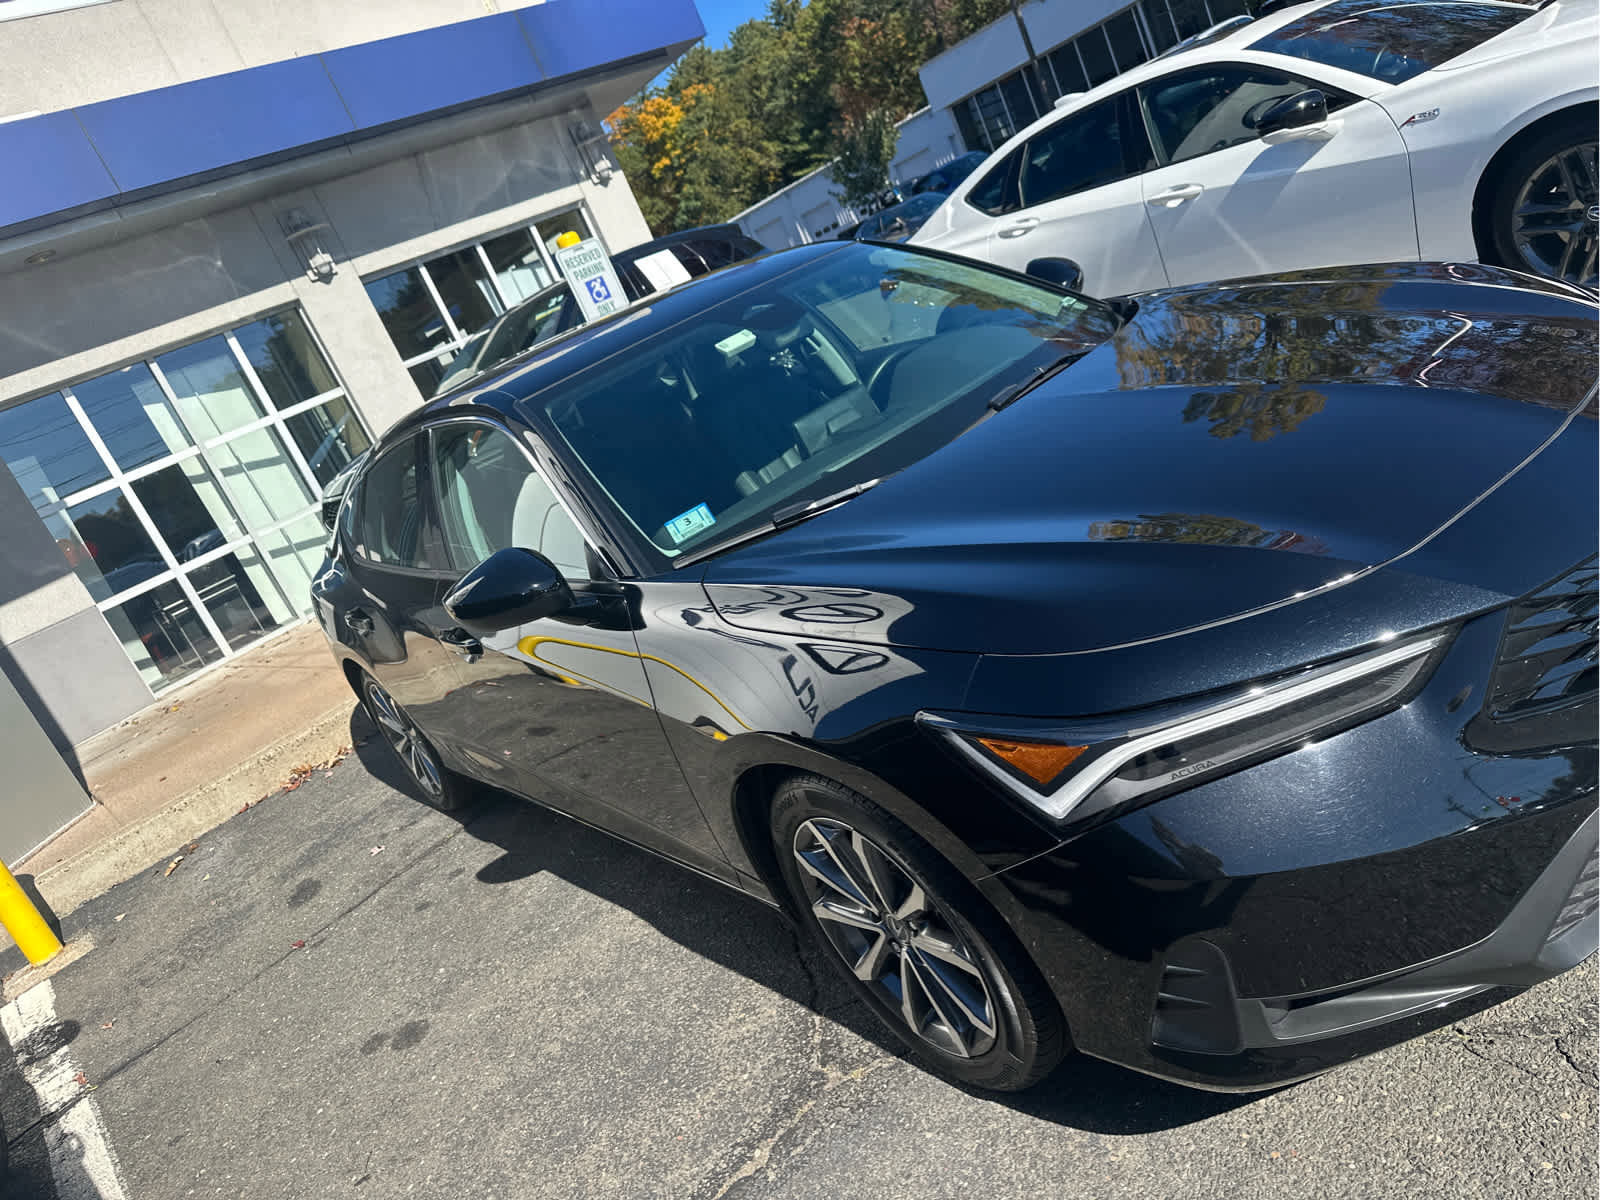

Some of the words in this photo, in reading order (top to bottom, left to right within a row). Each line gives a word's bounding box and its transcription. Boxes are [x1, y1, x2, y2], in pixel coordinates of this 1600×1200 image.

[565, 247, 602, 269] RESERVED
[573, 262, 605, 280] PARKING
[597, 300, 616, 315] ONLY
[683, 517, 692, 527] 3
[1171, 760, 1216, 780] ACURA
